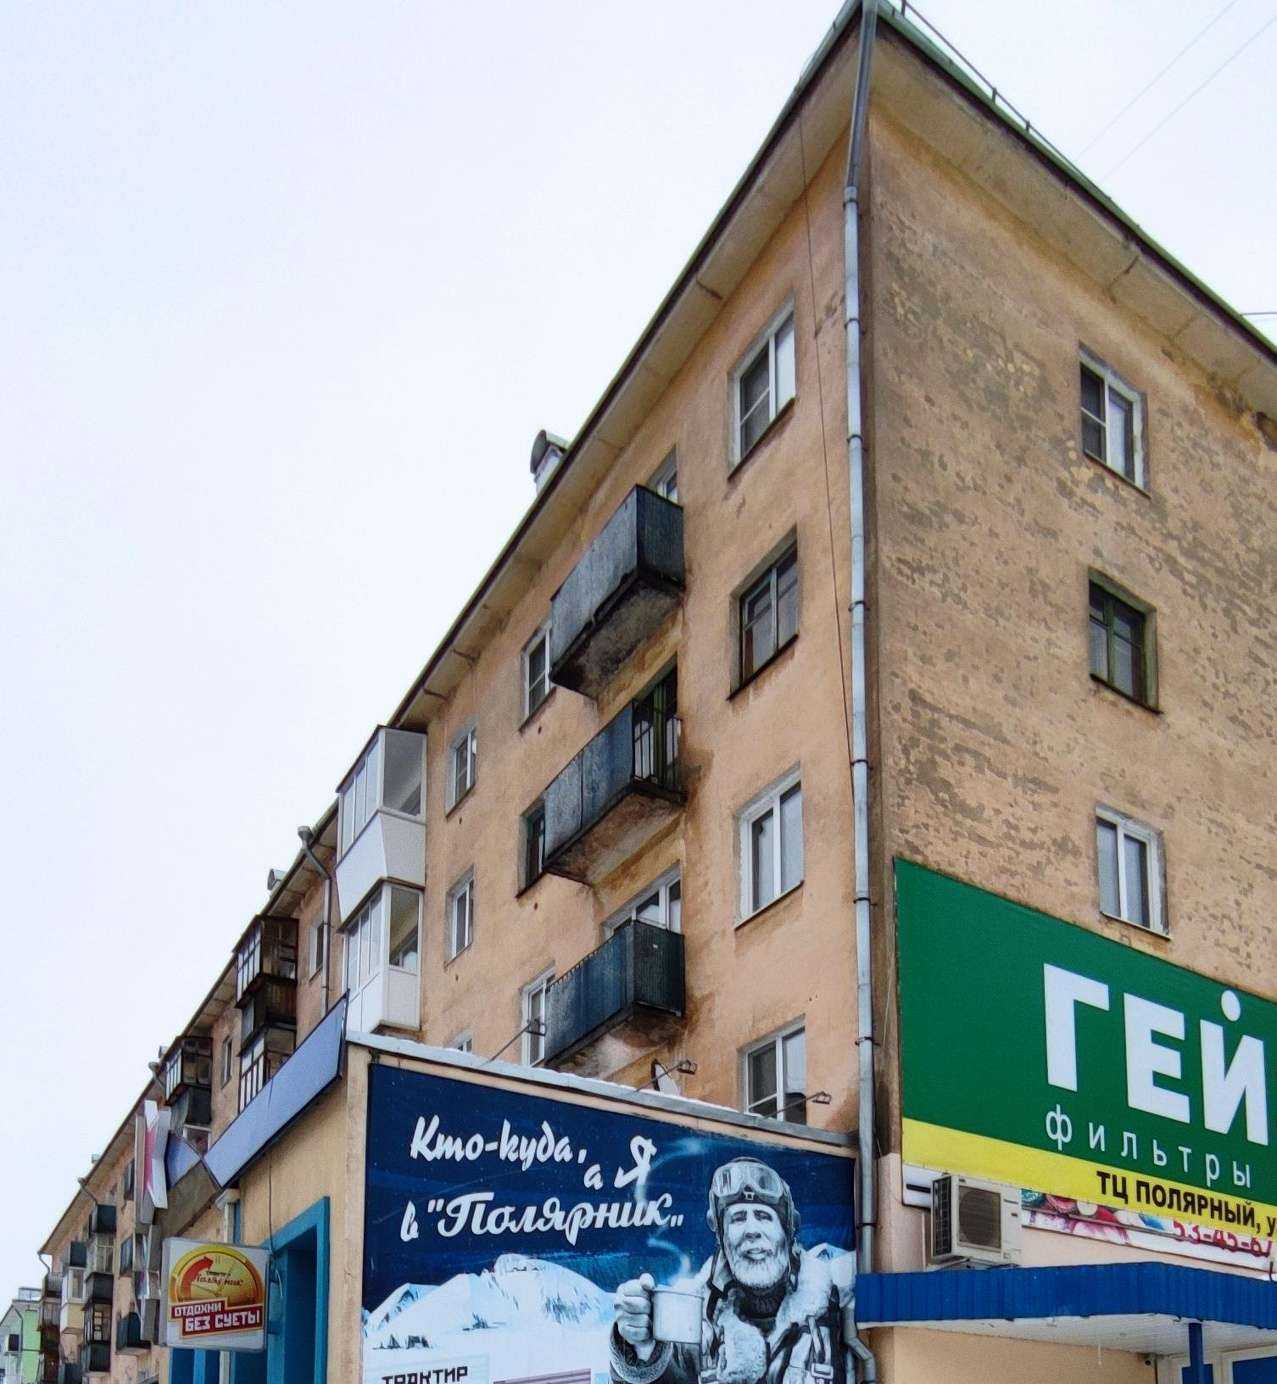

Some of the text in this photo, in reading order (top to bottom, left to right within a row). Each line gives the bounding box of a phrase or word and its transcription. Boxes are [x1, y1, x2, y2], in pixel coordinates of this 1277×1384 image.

[1043, 962, 1270, 1146] ГЕЙ
[409, 1114, 588, 1172] Кто-куда,
[614, 1134, 658, 1194] Я
[1045, 1104, 1251, 1188] фильтры
[1096, 1170, 1129, 1204] ТЦ
[1136, 1179, 1261, 1234] ПОЛЯРНЫЙ,
[174, 1302, 222, 1318] ОТДОХНИ
[185, 1309, 260, 1332] БЕЗ СУЕТЫ
